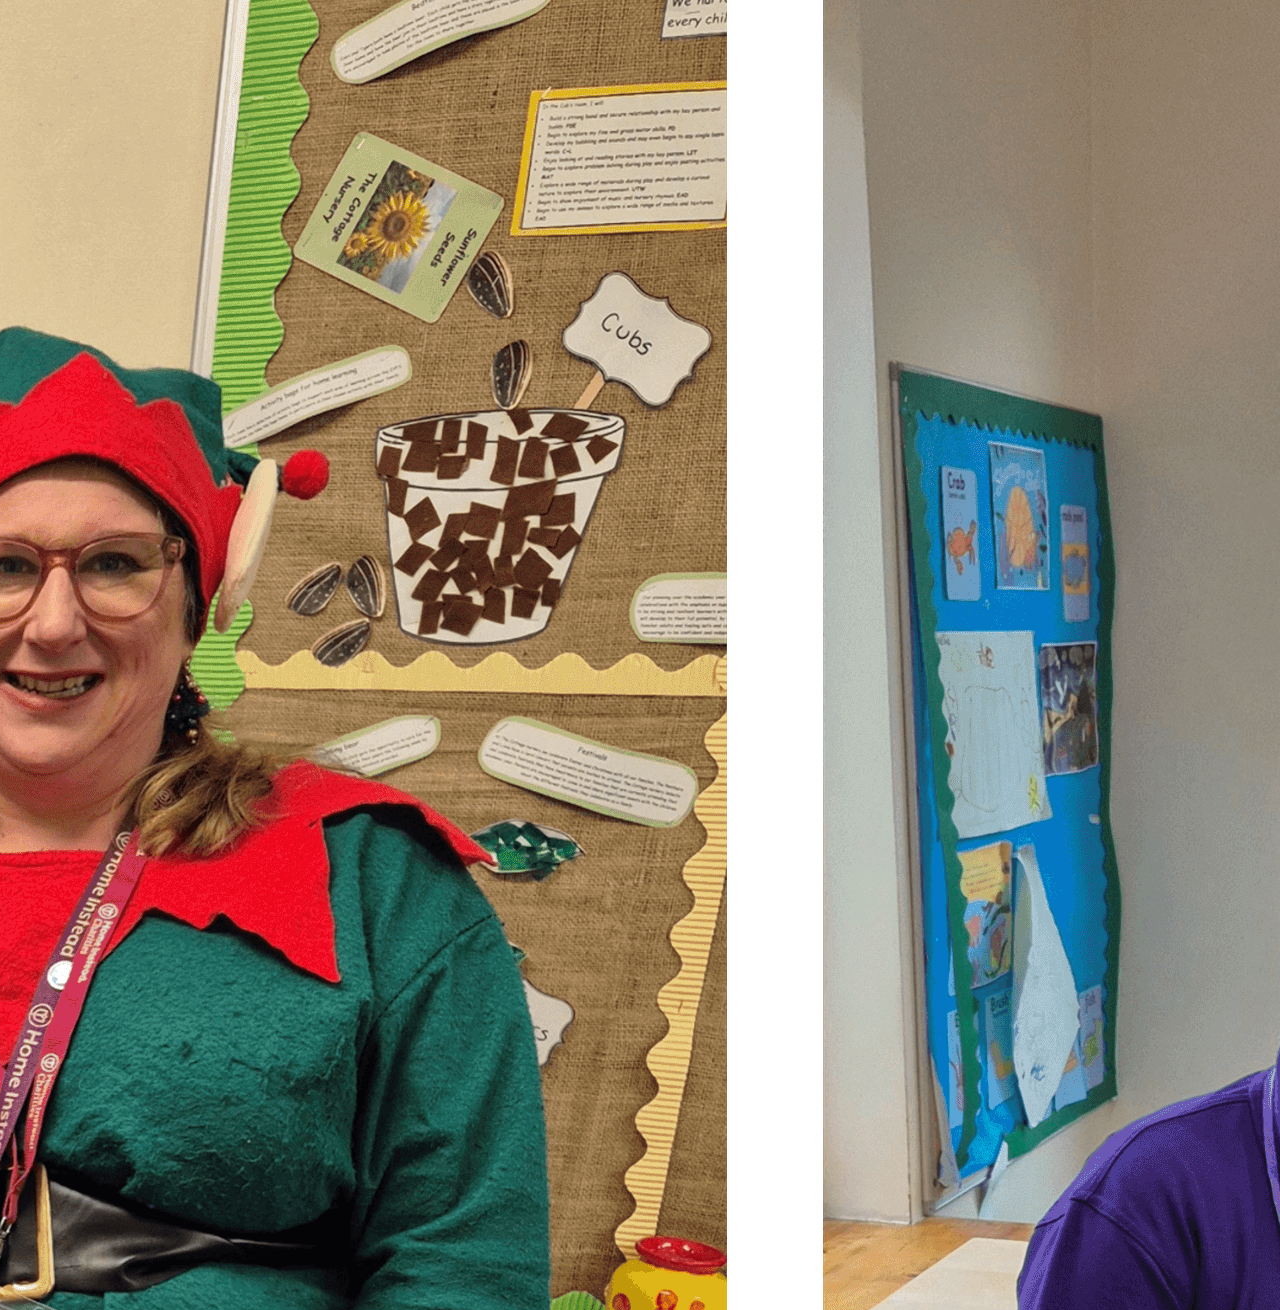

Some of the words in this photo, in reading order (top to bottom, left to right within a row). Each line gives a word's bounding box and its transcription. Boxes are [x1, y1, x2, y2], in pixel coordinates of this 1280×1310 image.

[667, 17, 702, 28] every
[323, 175, 356, 224] Nursery
[358, 172, 378, 194] The
[331, 197, 362, 243] Cottage
[430, 231, 456, 268] Seeds
[440, 228, 478, 287] Sunflower
[600, 311, 654, 358] Cubs
[332, 367, 357, 382] learning
[947, 471, 966, 491] Crab
[59, 896, 101, 959] Instead
[8, 1029, 42, 1088] Home
